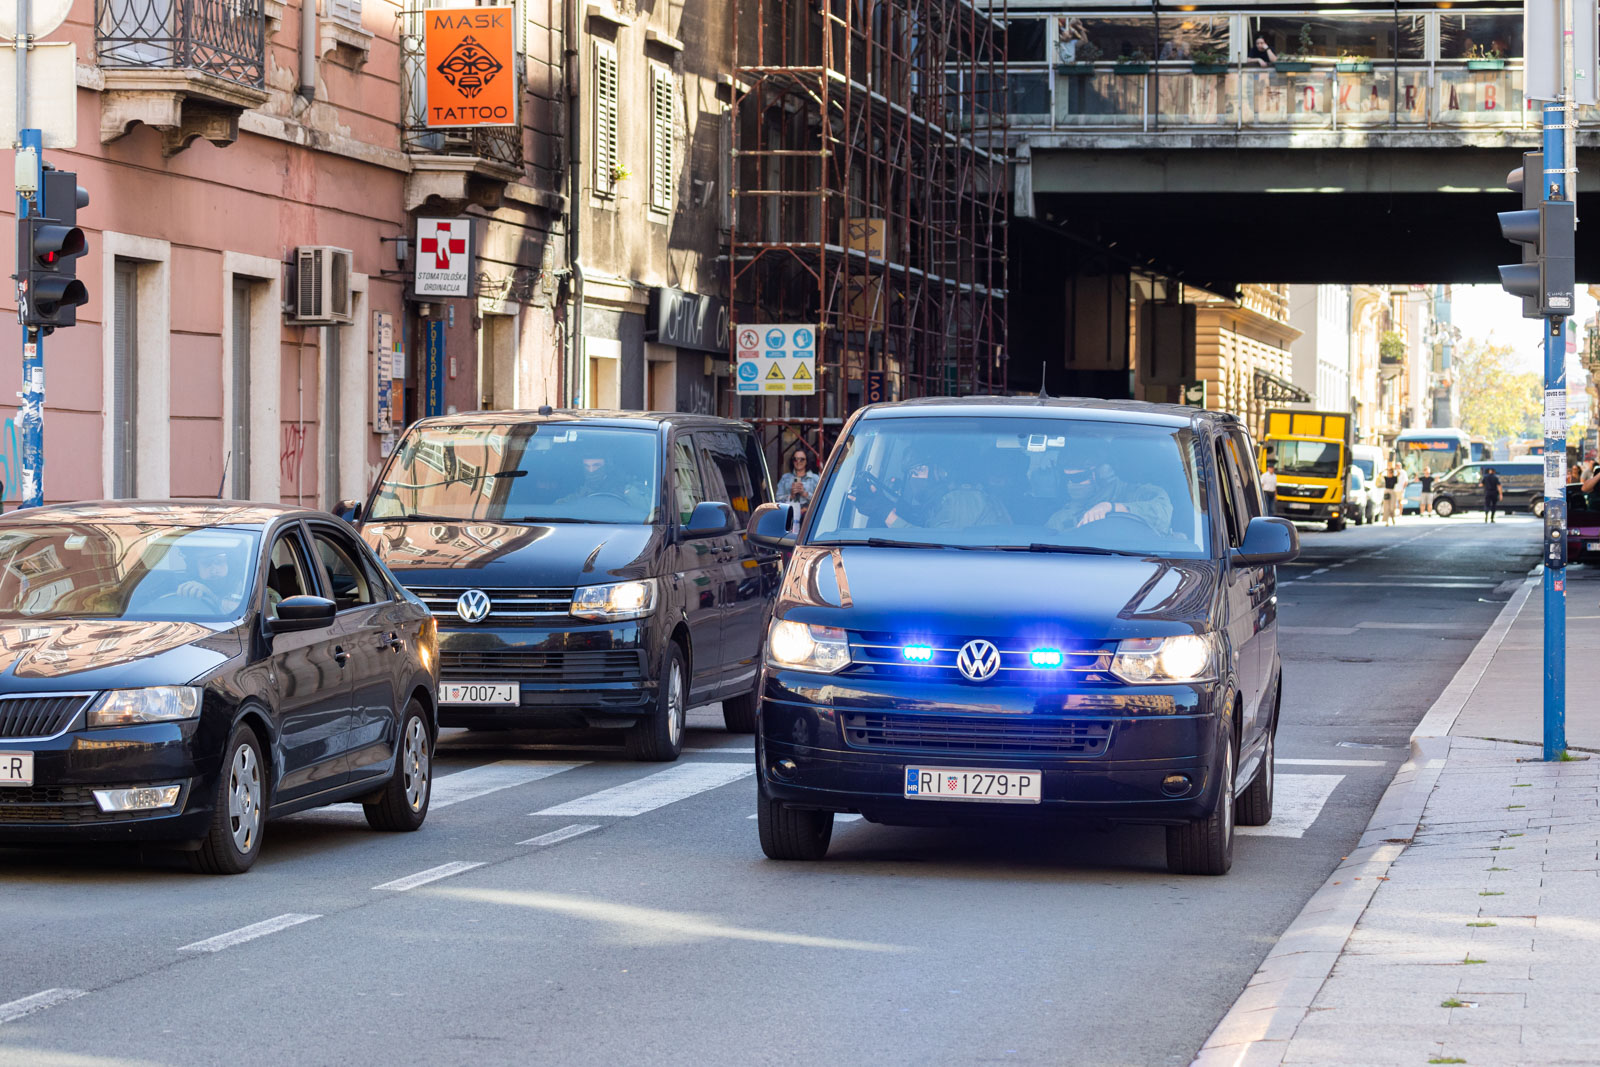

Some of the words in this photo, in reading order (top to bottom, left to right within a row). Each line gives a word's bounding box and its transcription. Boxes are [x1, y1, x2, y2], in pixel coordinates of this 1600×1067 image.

[434, 13, 505, 30] MASK
[433, 106, 508, 120] TATTOO
[417, 271, 467, 281] STOMATOLOŠKA
[424, 282, 460, 292] ORDINACIJA
[460, 686, 512, 702] 7007-J
[907, 784, 918, 792] HR
[920, 772, 942, 793] RI
[962, 773, 1031, 796] 1279-P
